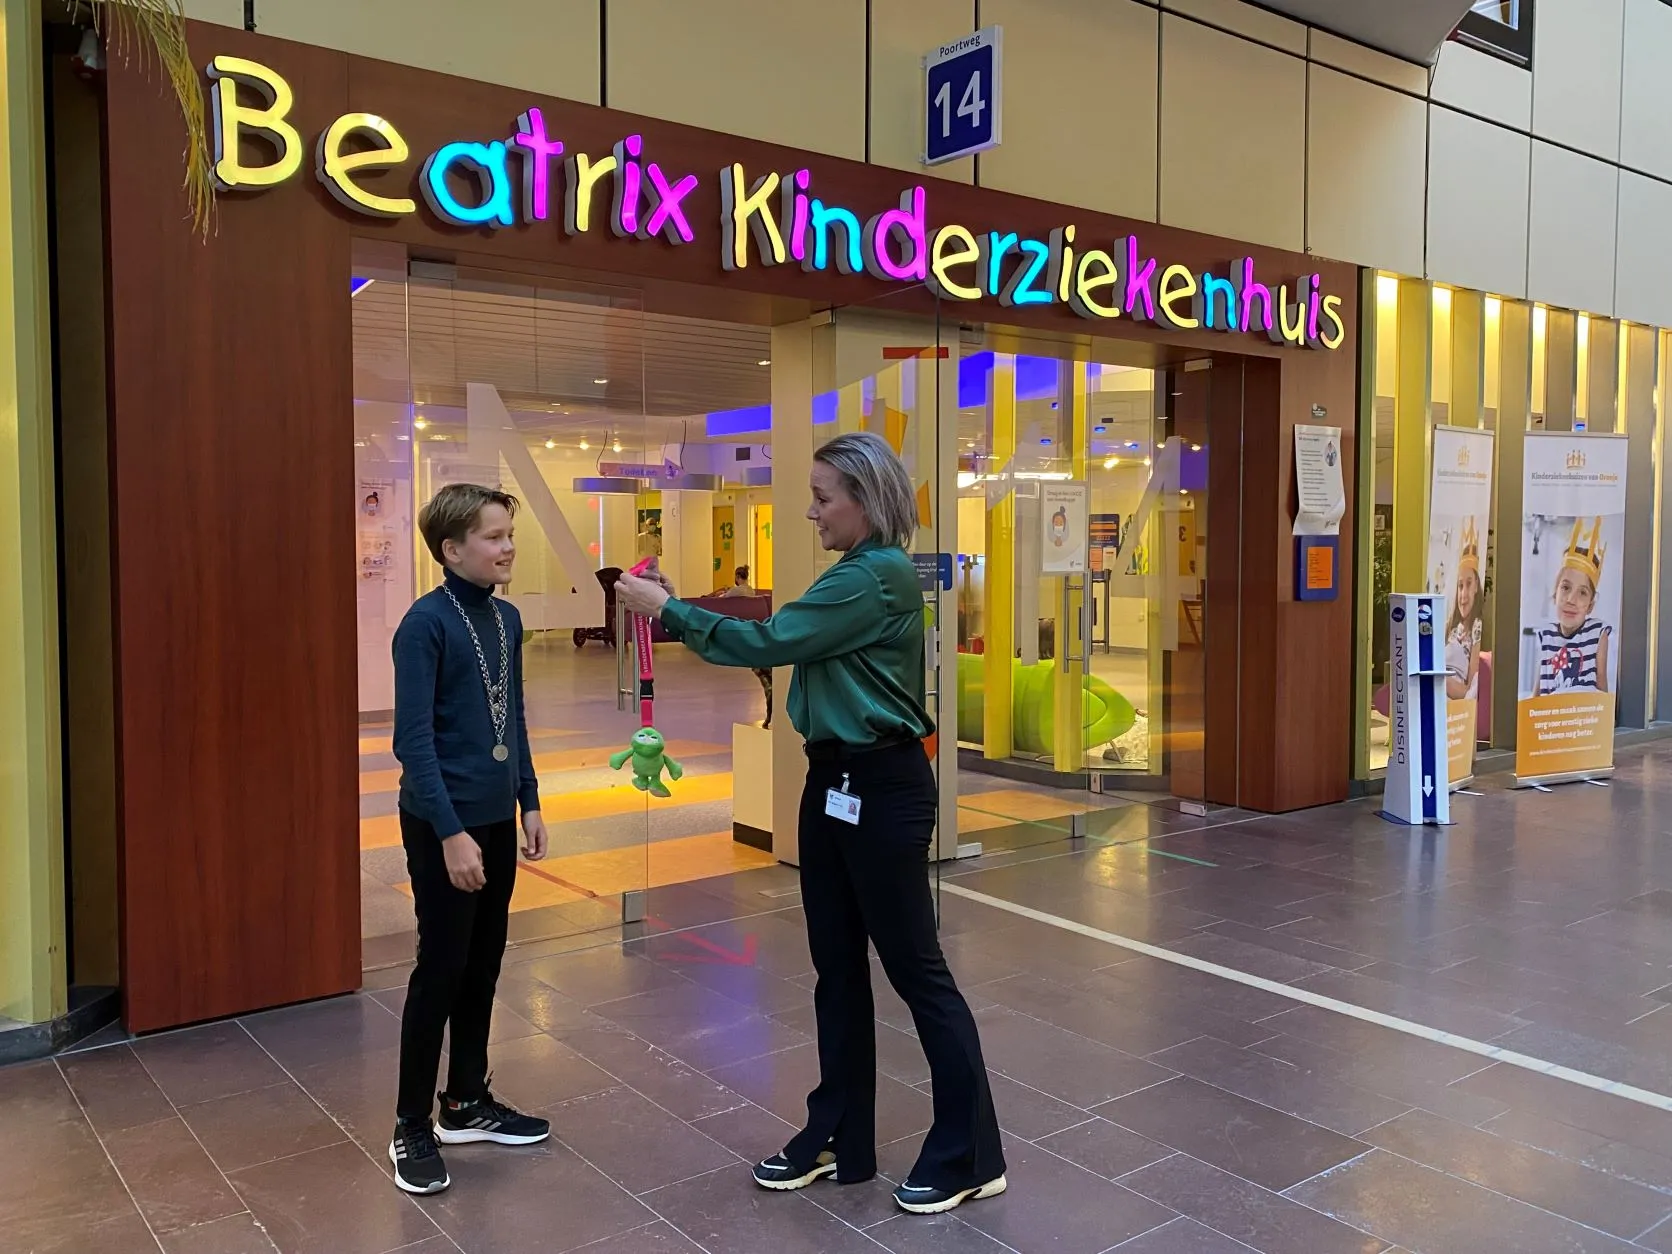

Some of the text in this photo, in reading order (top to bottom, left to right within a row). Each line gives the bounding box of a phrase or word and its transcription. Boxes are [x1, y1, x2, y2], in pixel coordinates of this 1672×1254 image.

[940, 34, 981, 57] Poortweg
[934, 70, 986, 138] 14
[208, 55, 1345, 349] Beatrix Kinderziekenhuis
[719, 522, 734, 540] 13
[761, 521, 773, 540] 1
[1394, 633, 1405, 765] DISINFECTANT
